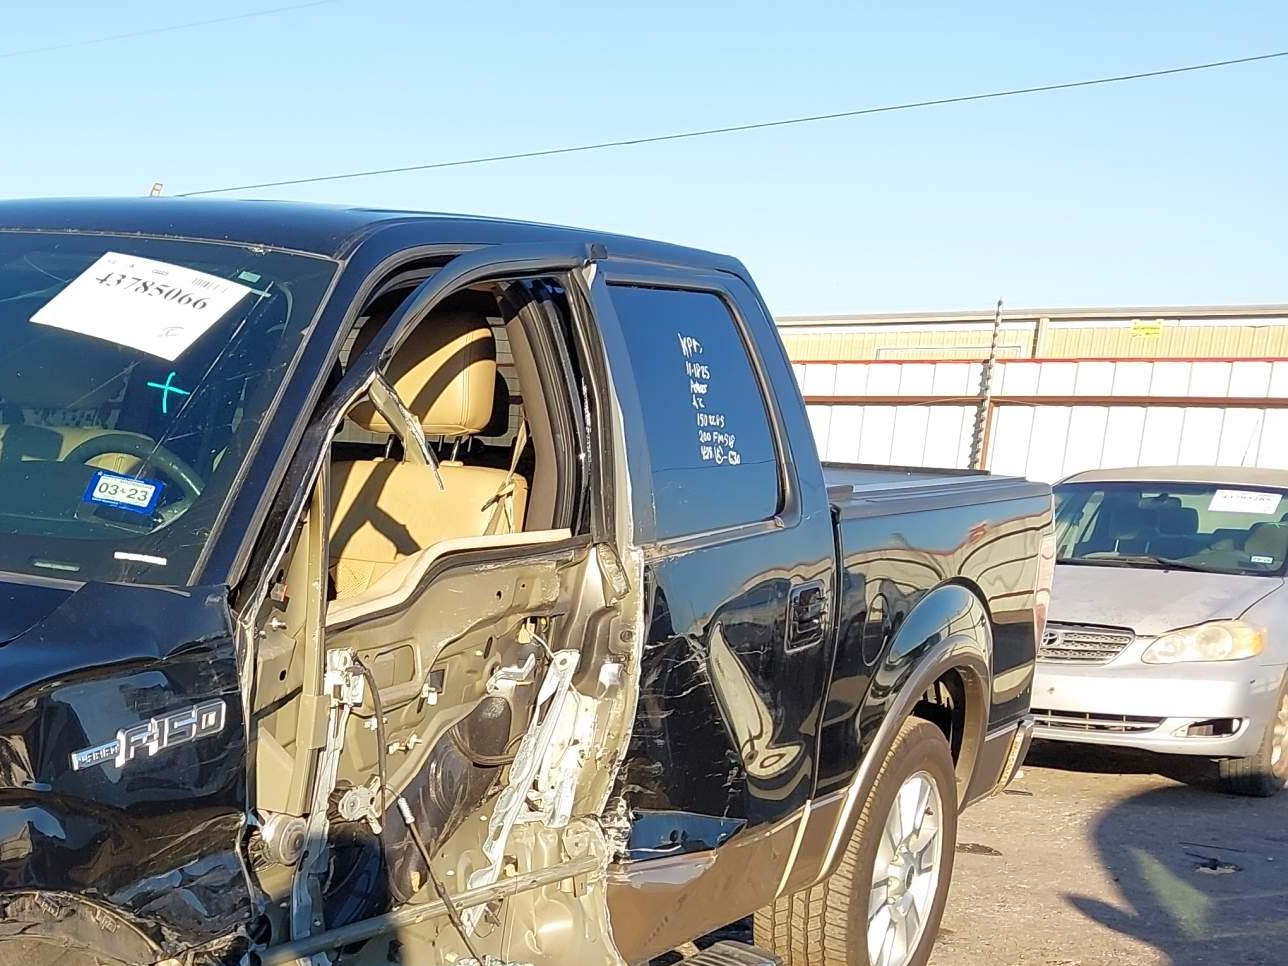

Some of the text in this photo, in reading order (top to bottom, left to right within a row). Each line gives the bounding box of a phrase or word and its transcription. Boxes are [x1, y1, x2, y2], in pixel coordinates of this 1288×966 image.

[96, 271, 211, 311] 43785066
[98, 482, 119, 496] 03
[126, 488, 149, 502] 23
